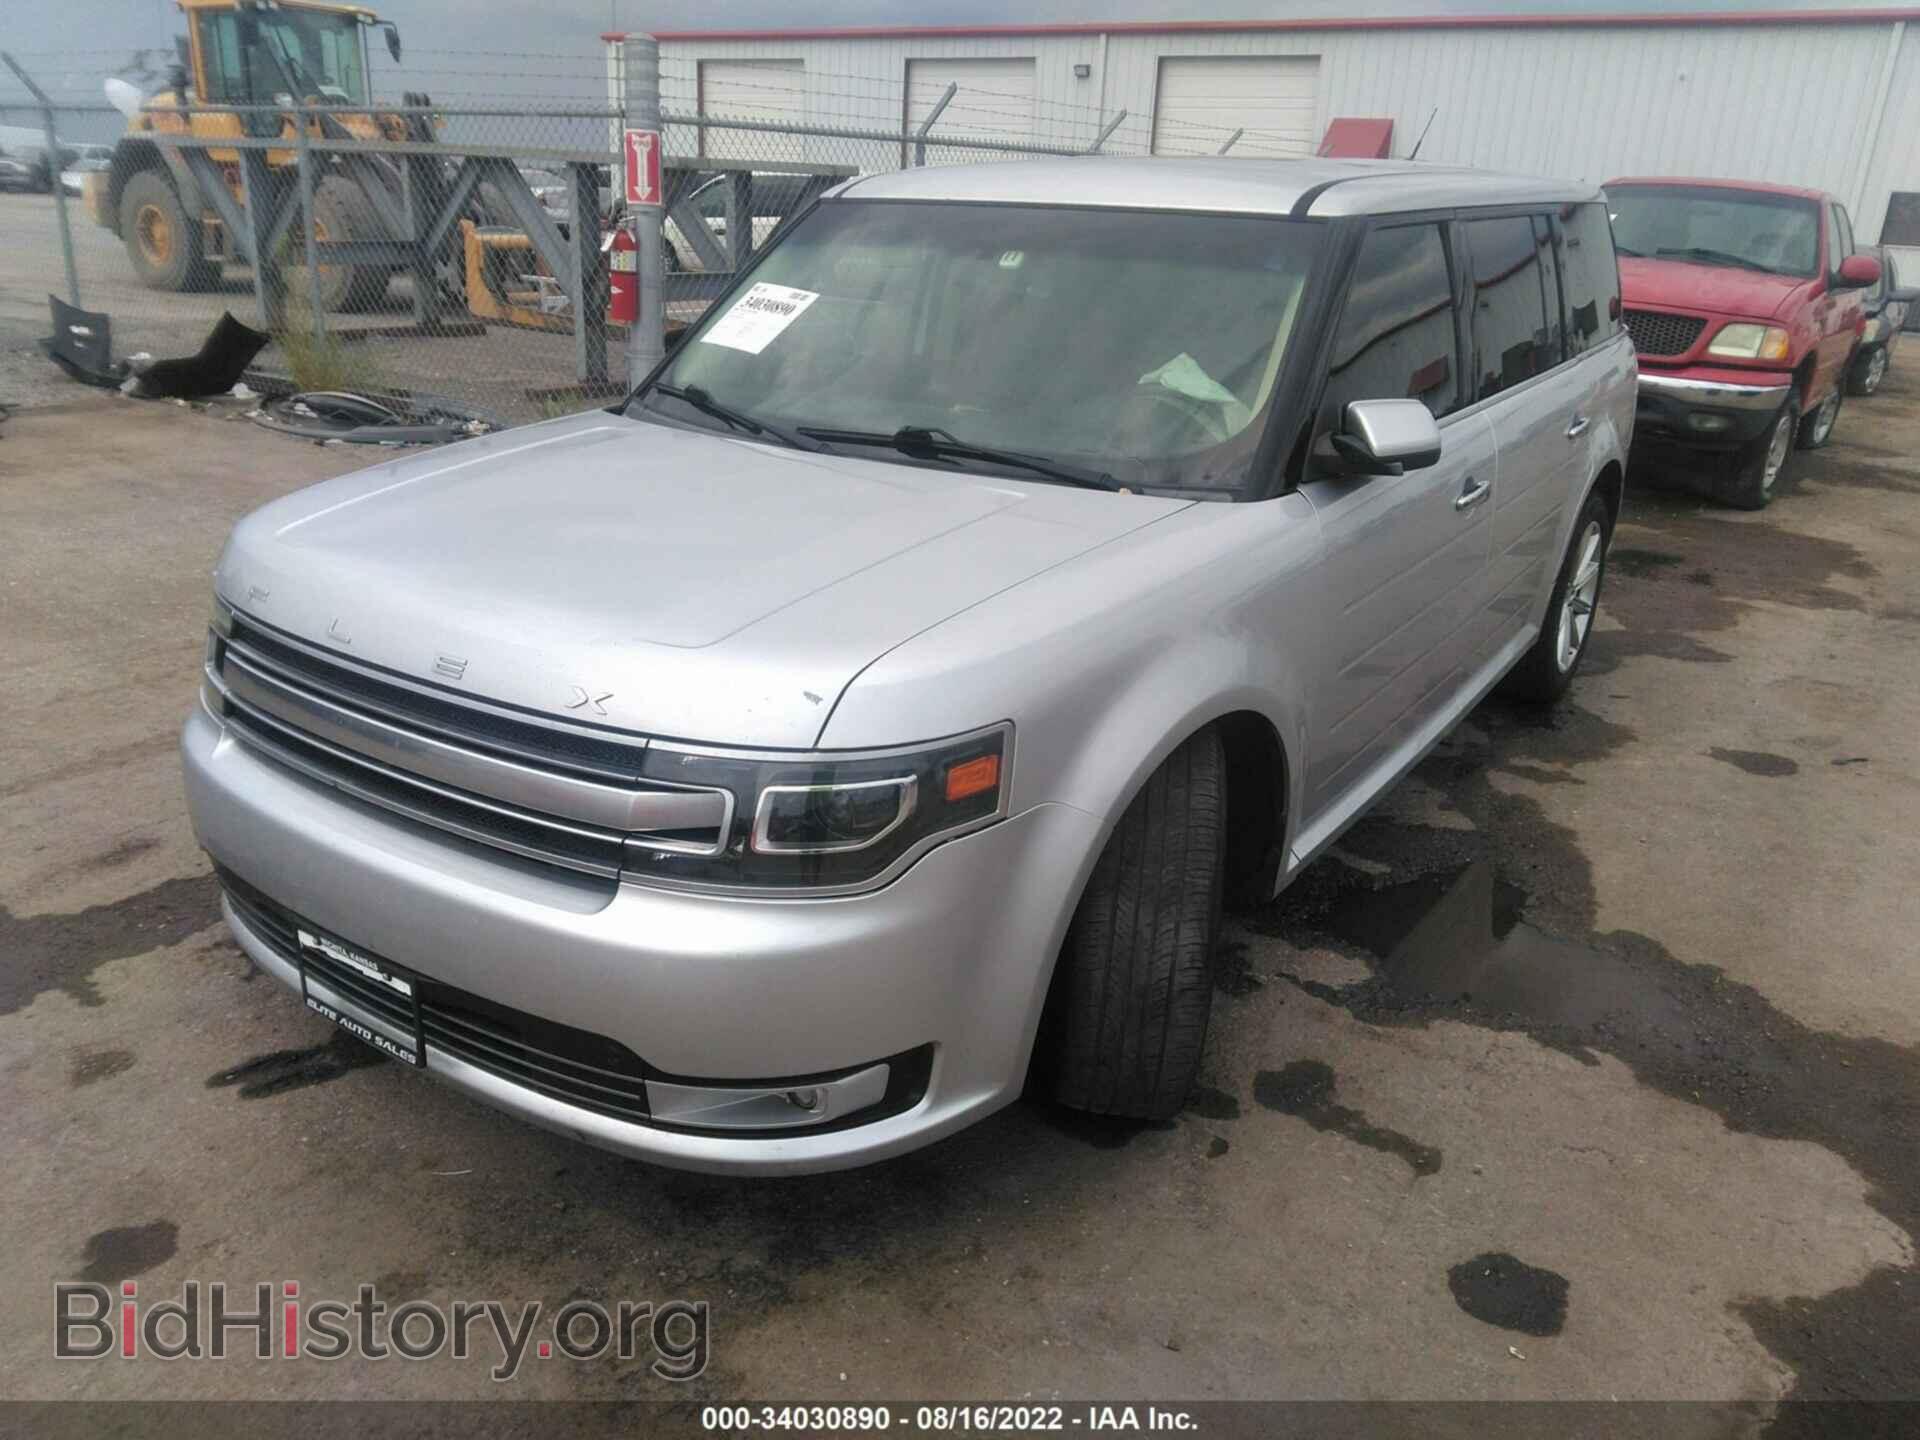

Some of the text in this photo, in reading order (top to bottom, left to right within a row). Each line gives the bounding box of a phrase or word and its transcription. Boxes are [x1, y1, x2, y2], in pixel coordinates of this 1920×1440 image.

[306, 998, 417, 1065] ELITE AUTO SALES
